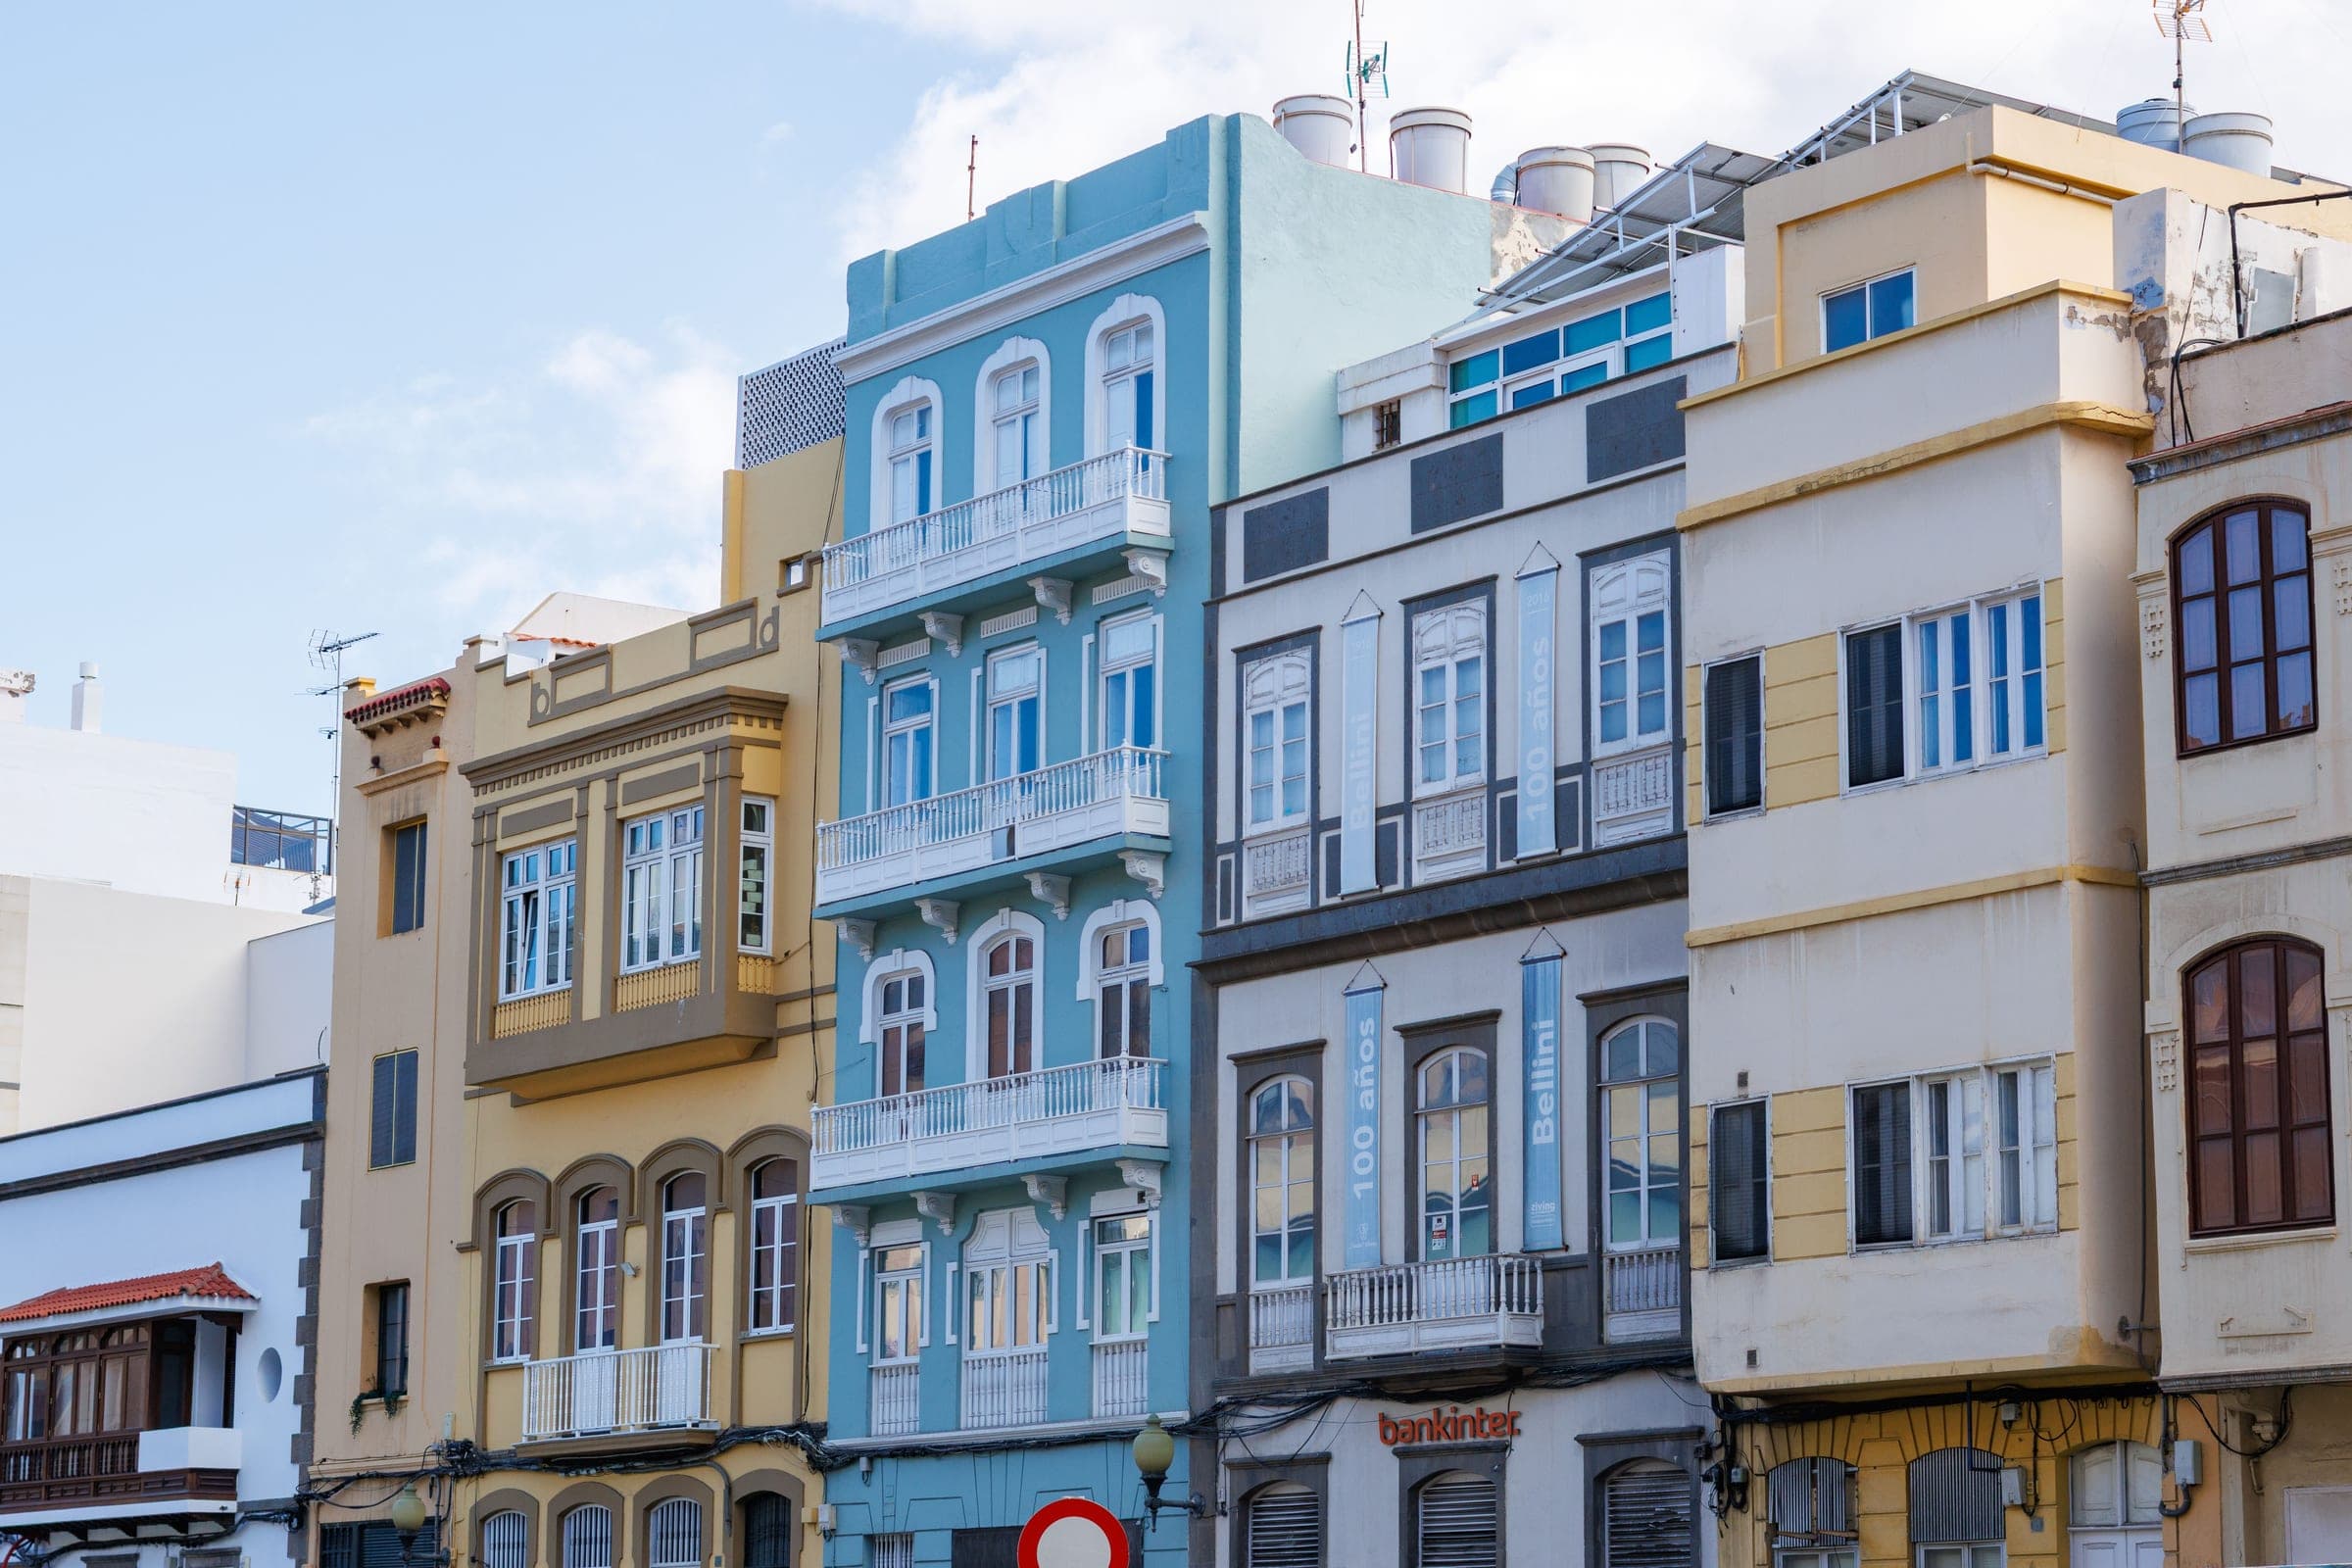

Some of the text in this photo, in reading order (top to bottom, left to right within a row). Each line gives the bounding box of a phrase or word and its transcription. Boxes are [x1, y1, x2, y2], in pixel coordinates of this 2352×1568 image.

[1348, 712, 1372, 831] Bellini
[1526, 636, 1549, 822] 100 años
[1352, 1016, 1375, 1200] 100 años
[1530, 1018, 1555, 1146] Bellini
